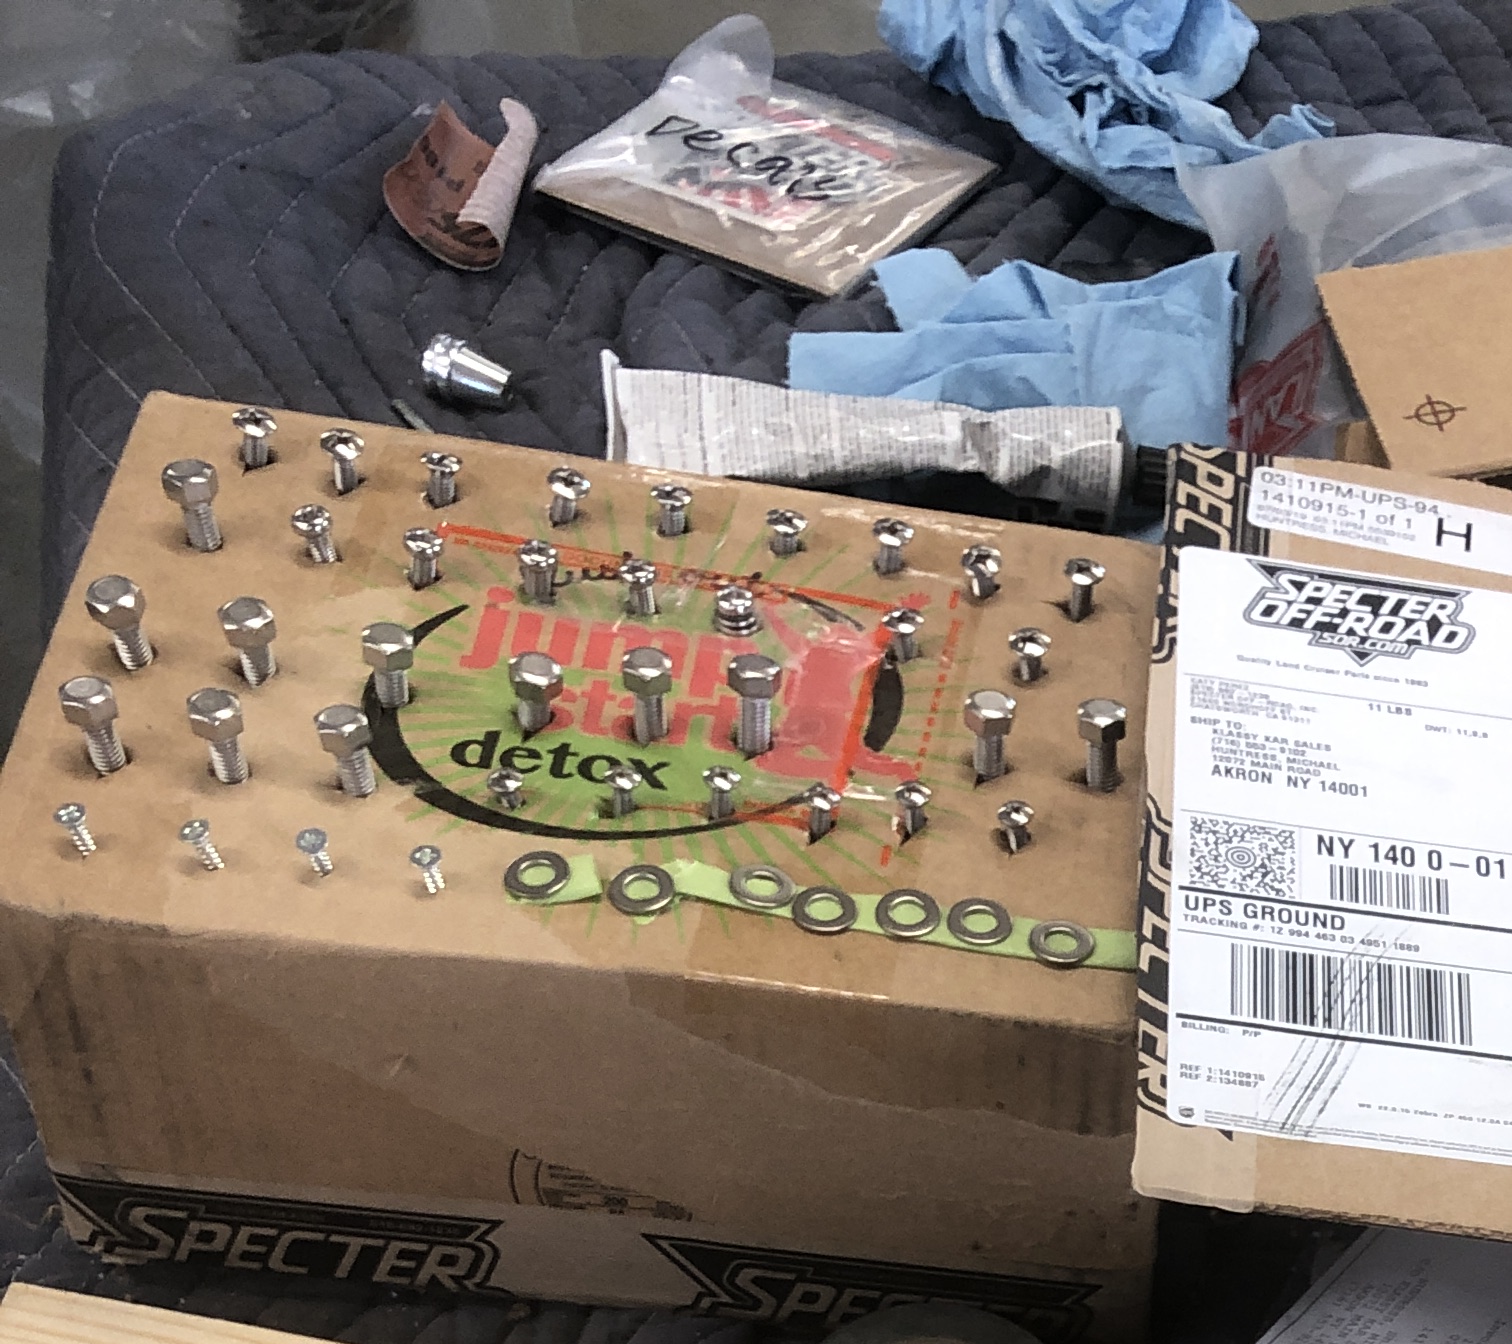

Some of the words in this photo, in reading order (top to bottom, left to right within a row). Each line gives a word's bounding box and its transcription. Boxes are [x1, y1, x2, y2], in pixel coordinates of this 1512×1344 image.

[1375, 513, 1397, 527] of
[1405, 518, 1413, 529] 1
[1436, 517, 1473, 552] H
[1265, 573, 1457, 625] SPECTER
[1248, 598, 1470, 650] OFF-ROAD
[1275, 659, 1301, 671] Land
[1190, 715, 1221, 727] SHIP
[1368, 702, 1382, 712] 11
[1387, 705, 1412, 716] LBS
[1212, 728, 1259, 742] KLASSY
[1264, 735, 1289, 746] KAR
[1294, 739, 1332, 752] SALES
[449, 729, 672, 791] detox
[1250, 759, 1283, 772] MAIN
[1287, 764, 1322, 777] ROAD
[1286, 756, 1341, 772] MICHAEL
[1211, 764, 1273, 785] AKRON
[1287, 775, 1311, 790] NY
[1319, 780, 1368, 798] 14001
[1317, 834, 1355, 859] NY
[1368, 842, 1416, 868] 140
[1184, 894, 1233, 917] UPS
[1242, 902, 1346, 932] GROUND
[1183, 913, 1248, 931] TRACKING
[1270, 925, 1284, 936] 1Z
[1288, 928, 1311, 939] 994
[1314, 931, 1337, 943] 463
[1181, 1021, 1230, 1035] BILLING:
[1242, 1029, 1262, 1038] P/P
[1179, 1062, 1202, 1072] REF
[1179, 1071, 1202, 1080] REF
[103, 1205, 478, 1293] SPECTER
